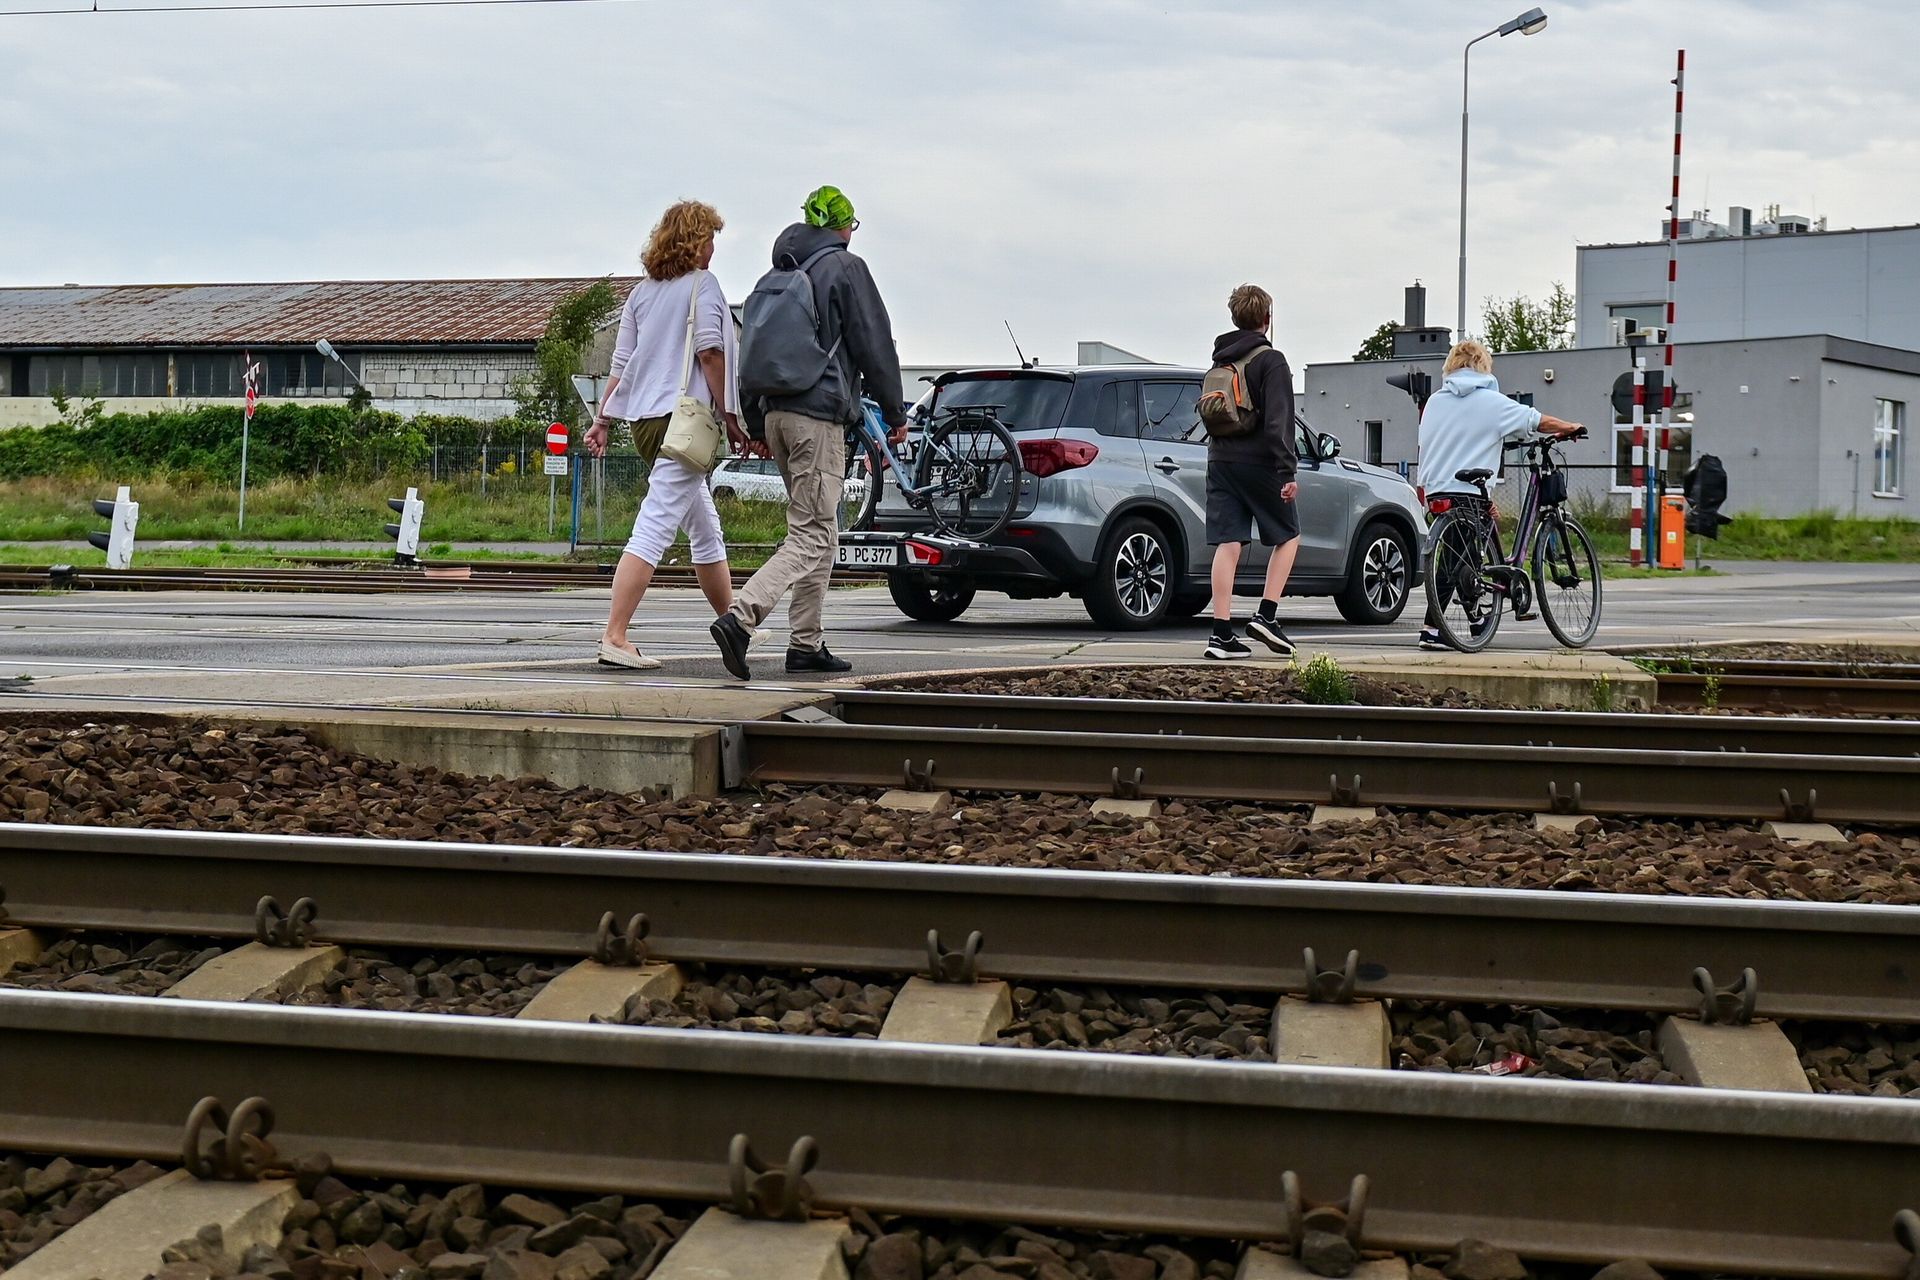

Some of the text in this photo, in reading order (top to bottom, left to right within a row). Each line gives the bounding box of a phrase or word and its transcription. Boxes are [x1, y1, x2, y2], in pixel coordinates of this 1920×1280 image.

[839, 547, 892, 563] B PC 377
